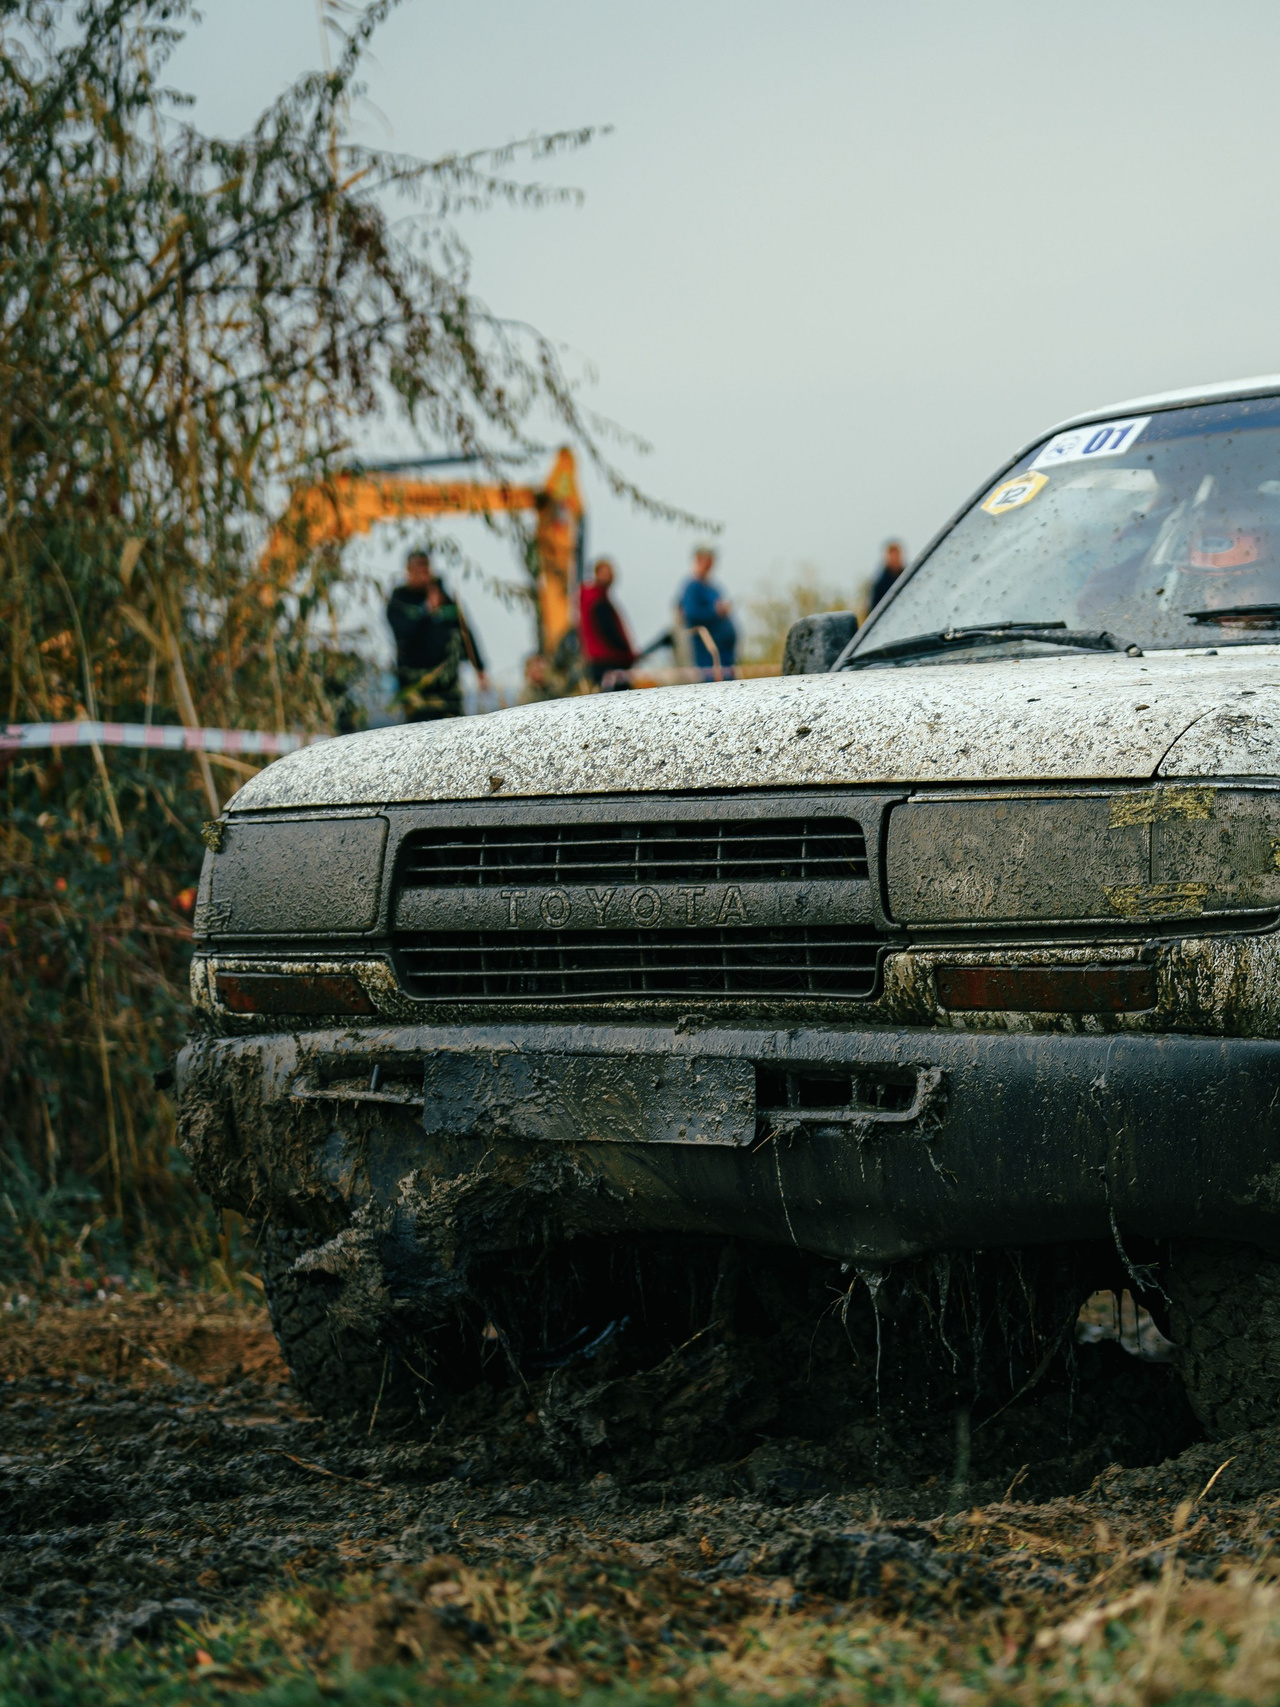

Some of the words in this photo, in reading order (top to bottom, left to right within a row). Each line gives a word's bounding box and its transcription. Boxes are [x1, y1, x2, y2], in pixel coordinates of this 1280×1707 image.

[1082, 423, 1135, 454] 01
[995, 486, 1027, 506] 12
[501, 886, 752, 928] TOYOTA
